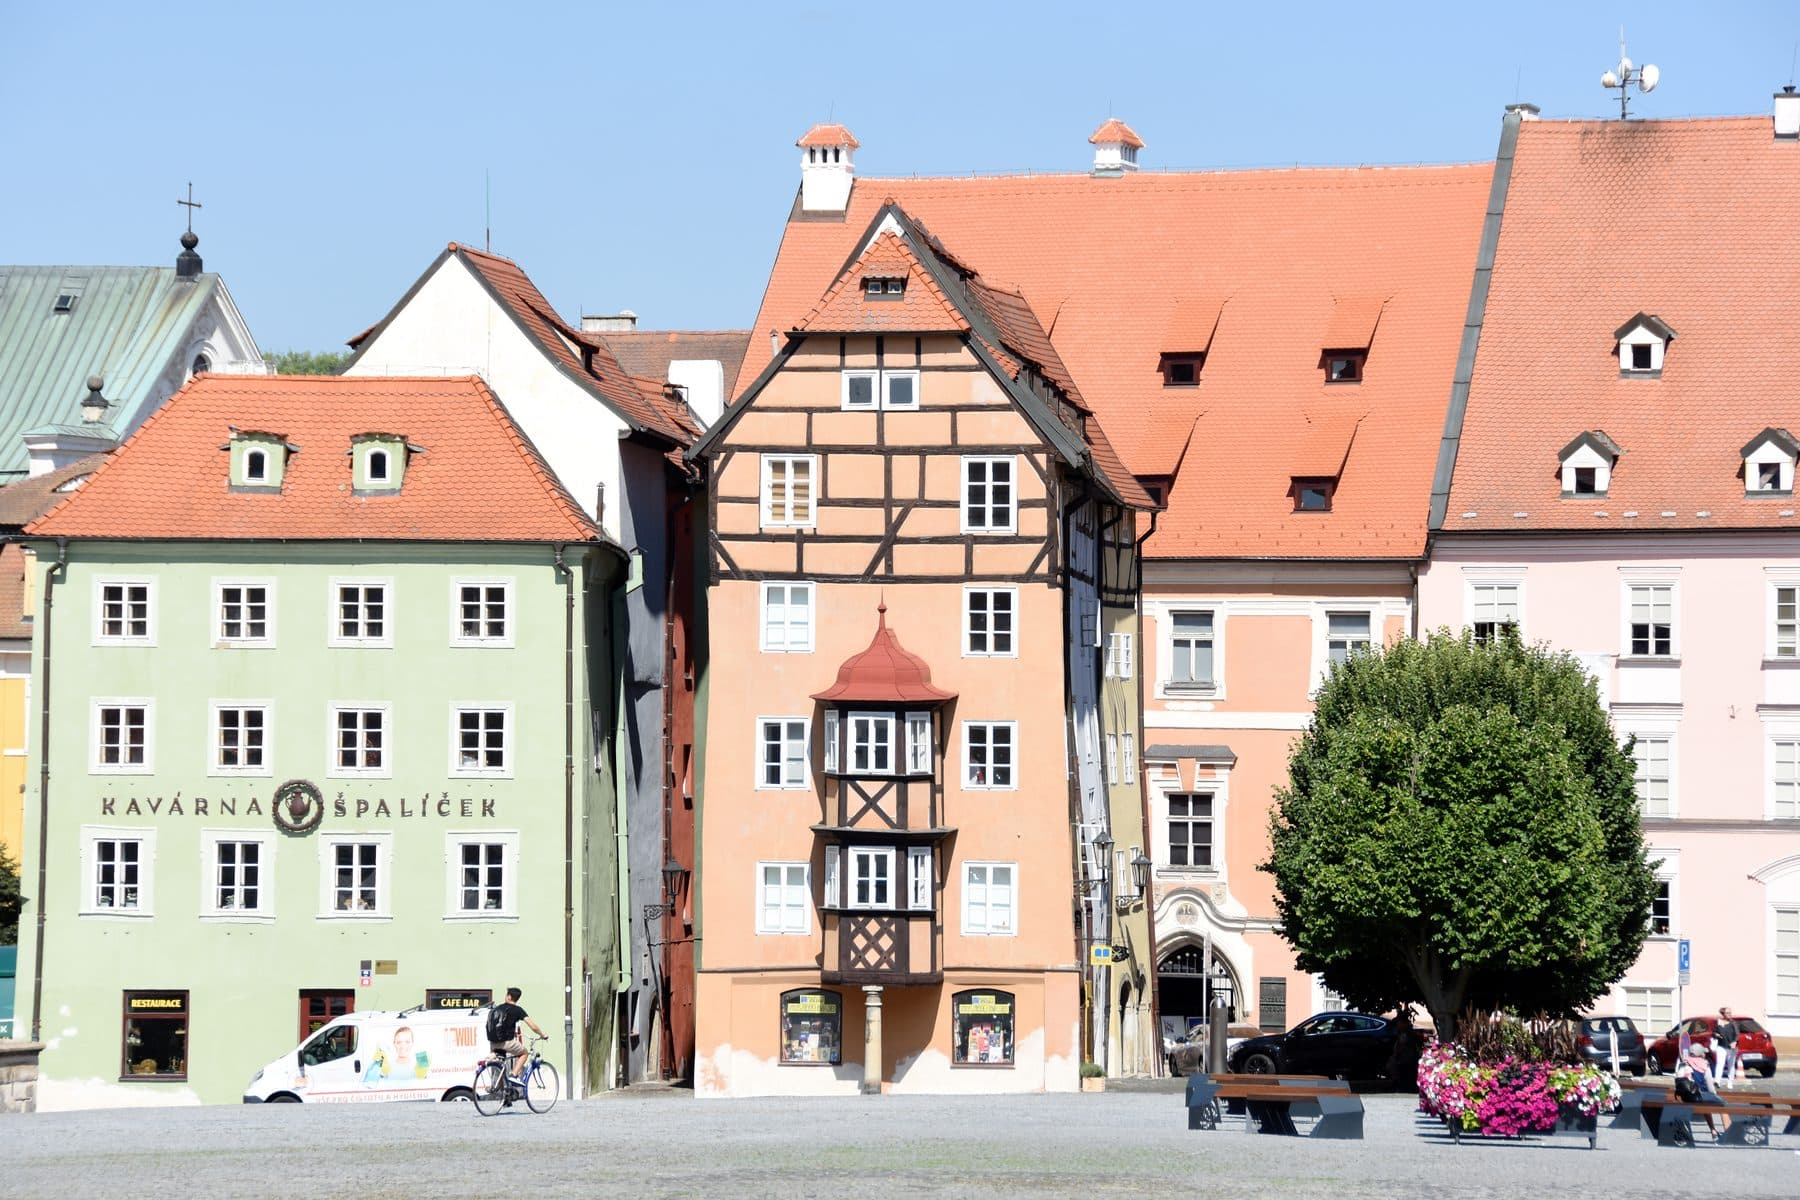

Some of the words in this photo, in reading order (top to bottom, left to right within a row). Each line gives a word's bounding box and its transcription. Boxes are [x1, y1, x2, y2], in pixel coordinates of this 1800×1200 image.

[102, 791, 262, 816] KAVÁRNA
[334, 792, 495, 818] ŠPALÍČEK
[131, 999, 182, 1008] RESTAURACE
[463, 998, 480, 1008] BAR
